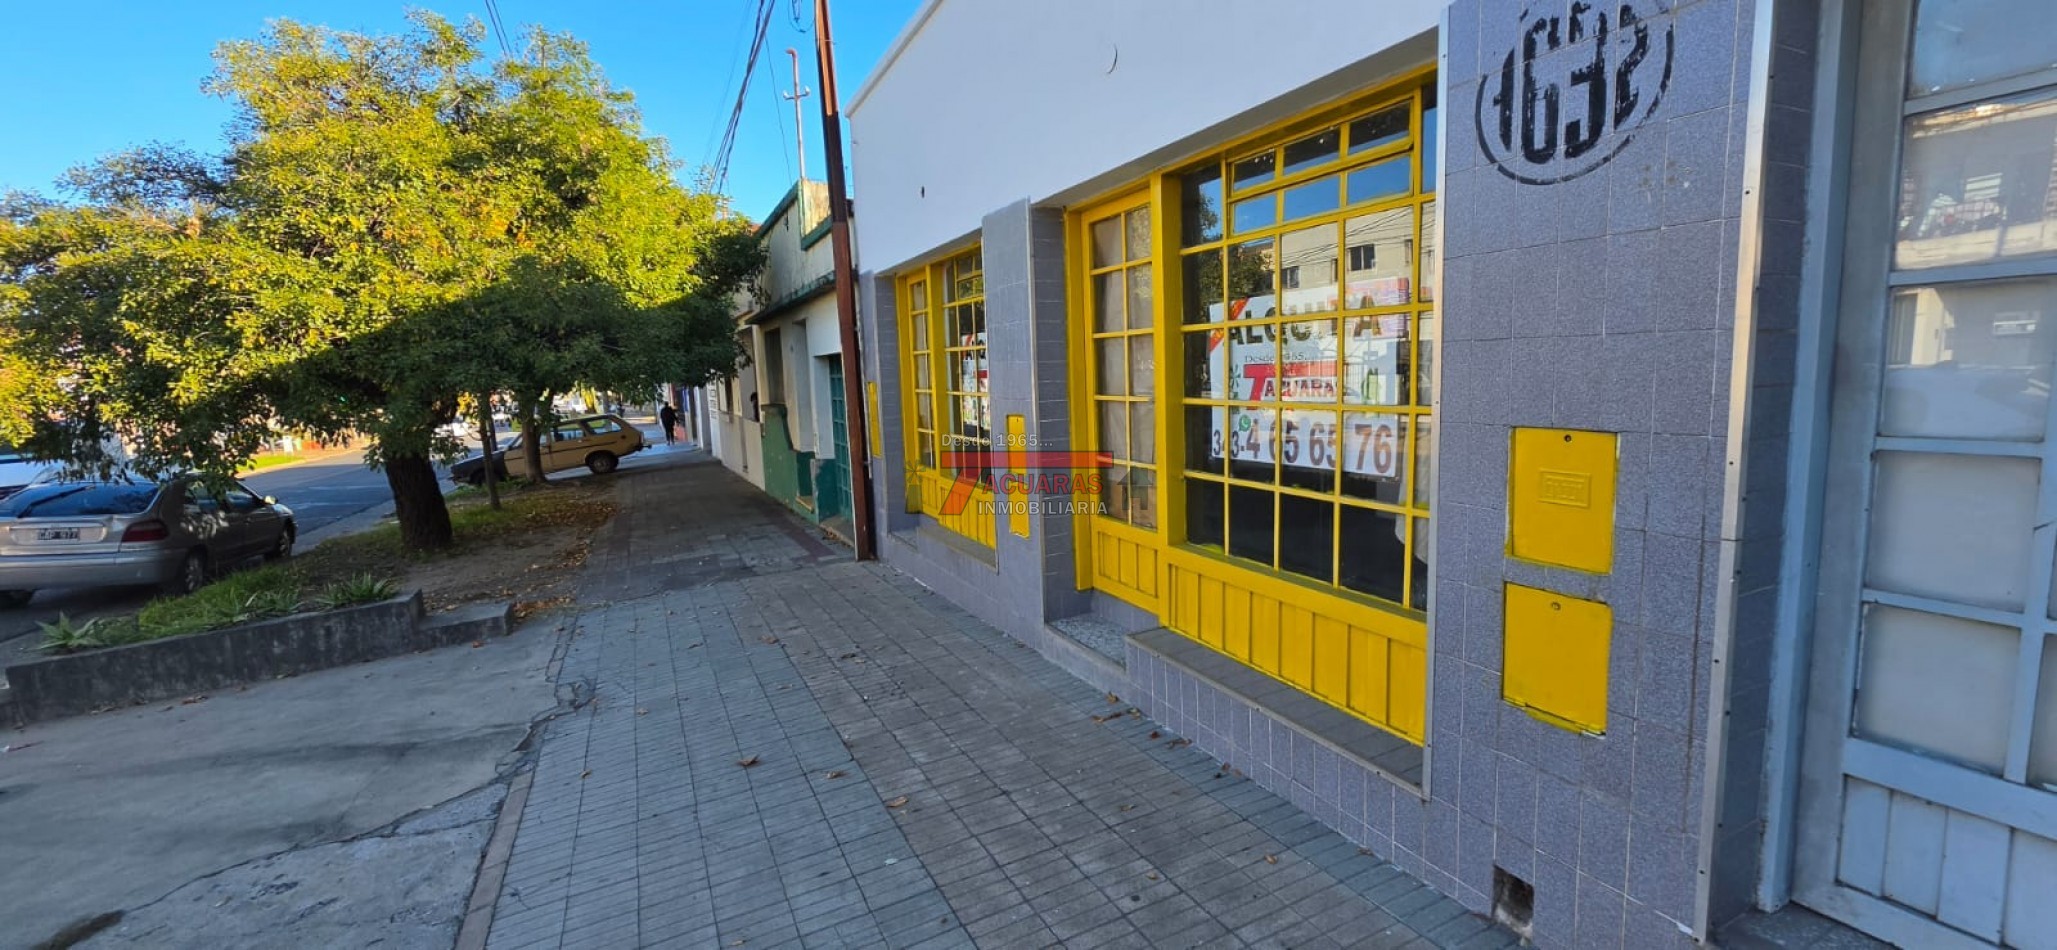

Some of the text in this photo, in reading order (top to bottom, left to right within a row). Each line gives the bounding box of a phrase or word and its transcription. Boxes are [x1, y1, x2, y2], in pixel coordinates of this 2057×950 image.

[1493, 1, 1648, 164] 1632
[1243, 360, 1343, 410] TACUARA
[1355, 423, 1393, 474] 76
